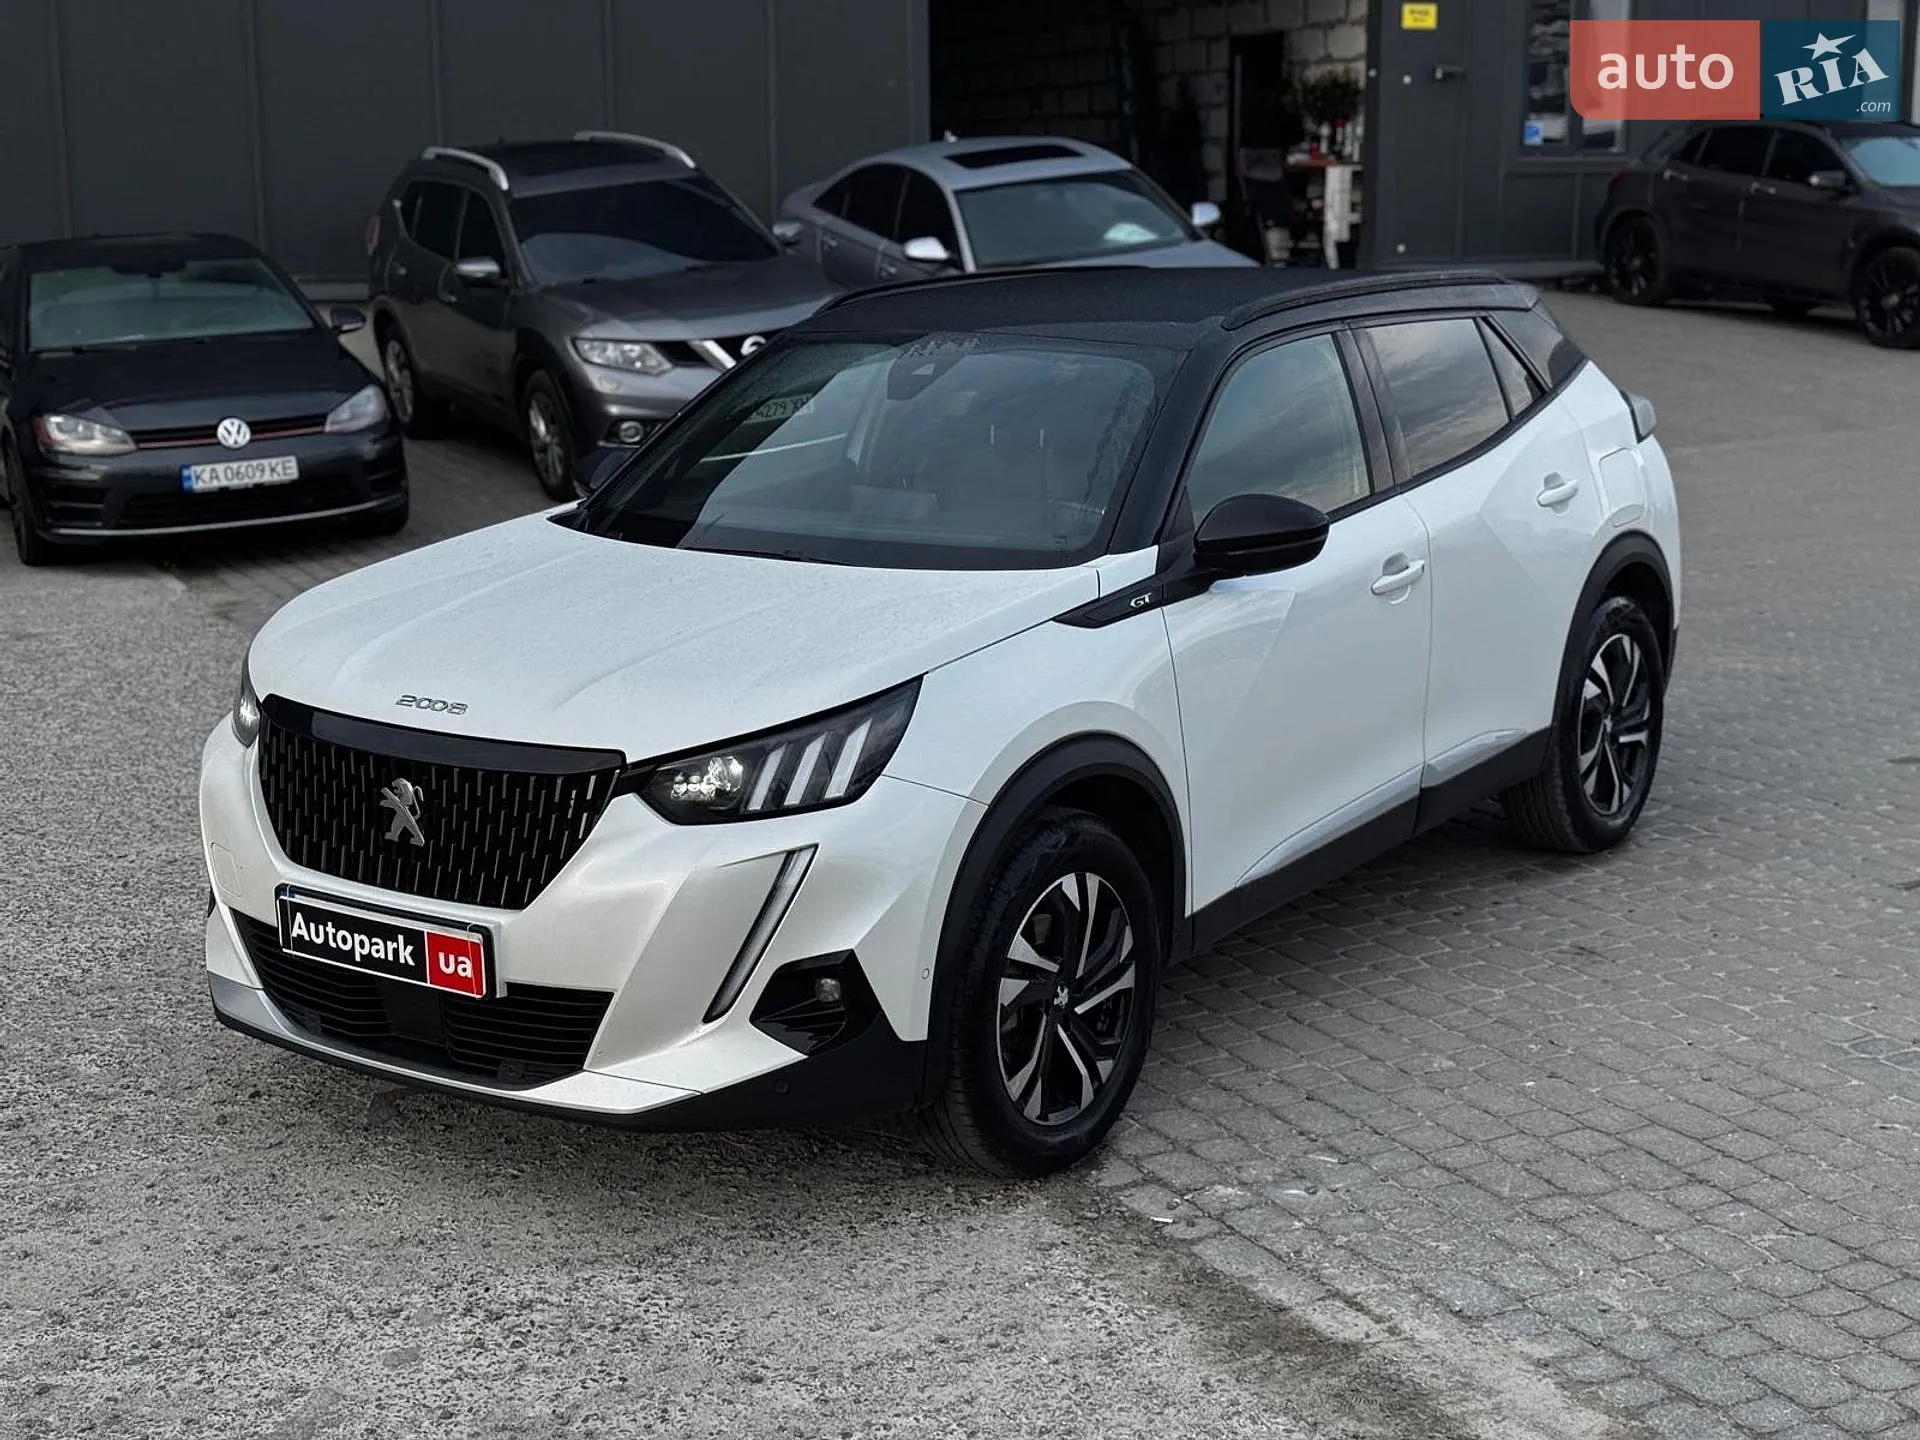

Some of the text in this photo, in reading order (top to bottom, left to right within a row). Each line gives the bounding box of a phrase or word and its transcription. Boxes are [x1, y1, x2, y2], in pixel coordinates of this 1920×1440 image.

[1130, 592, 1152, 608] GT
[395, 694, 468, 716] 2008
[291, 911, 473, 979] Autopark ua
